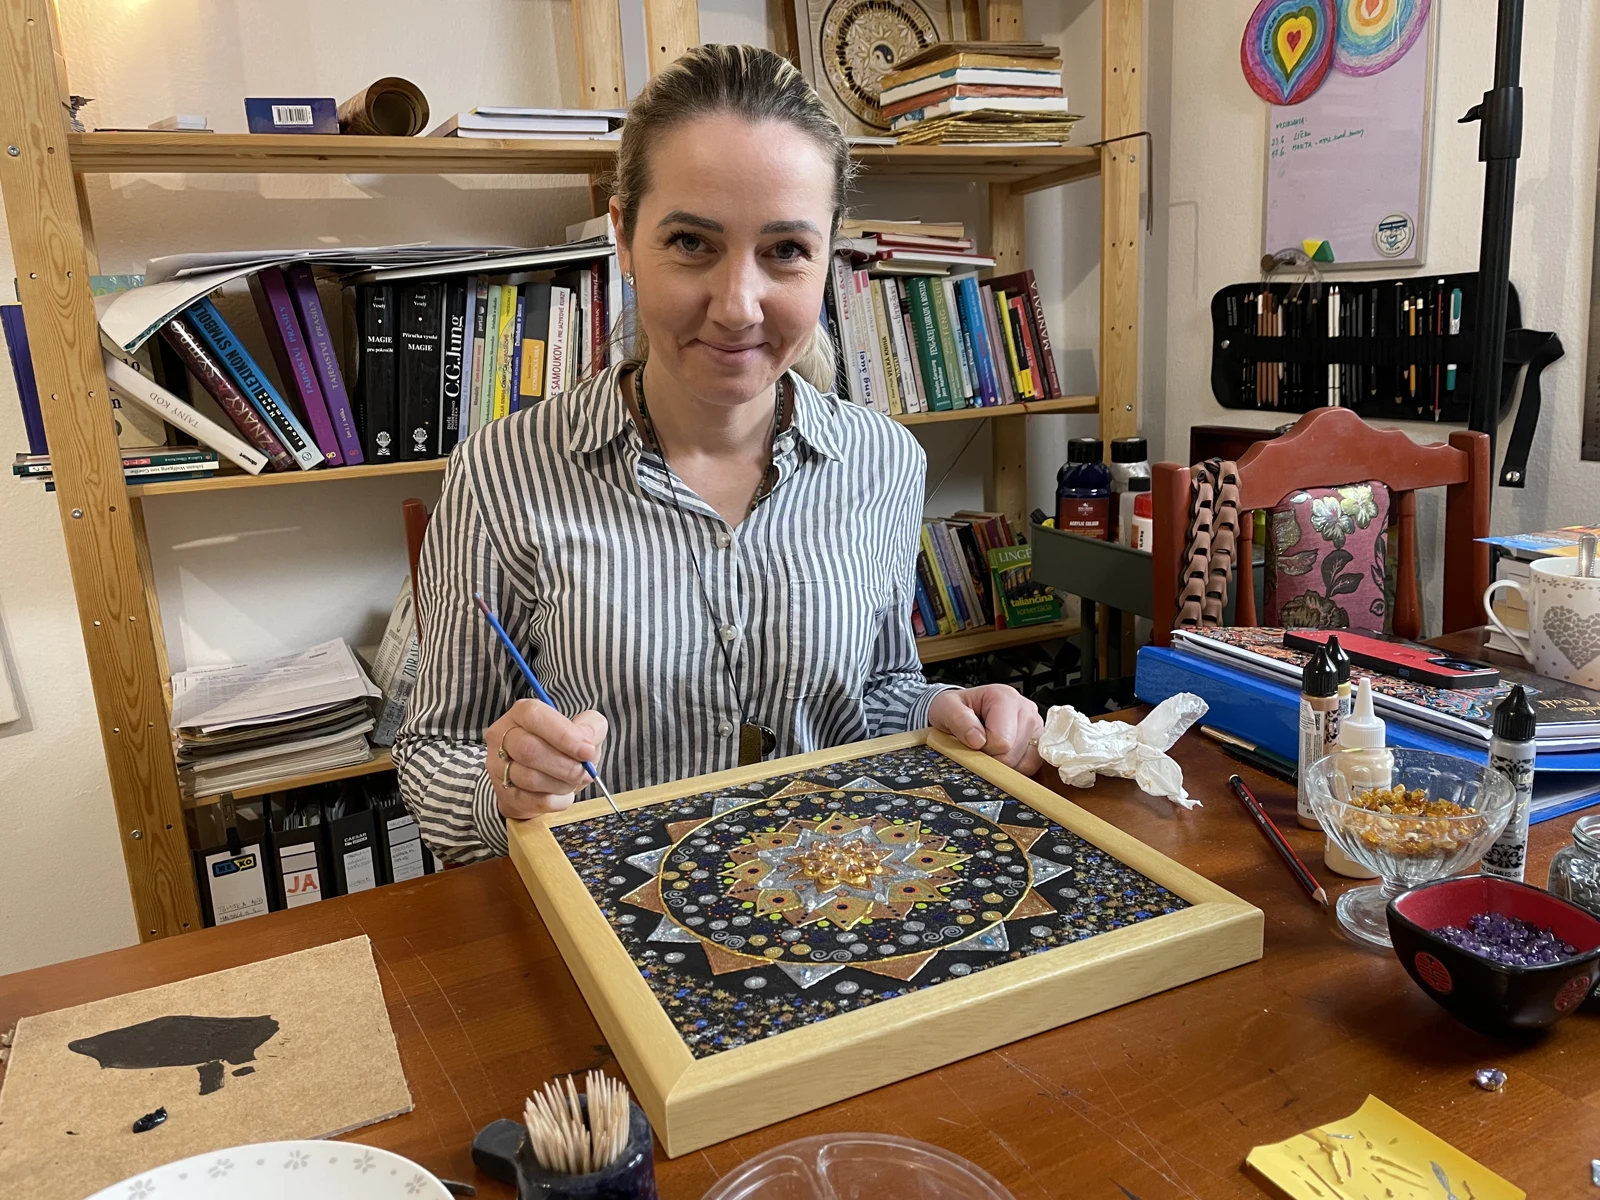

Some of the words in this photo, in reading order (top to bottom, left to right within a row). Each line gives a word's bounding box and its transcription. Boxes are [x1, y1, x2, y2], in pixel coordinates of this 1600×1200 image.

[407, 343, 433, 351] MAGIE
[551, 344, 562, 389] SAMOUKOV
[863, 377, 873, 406] Feng
[258, 394, 276, 418] Hans
[227, 396, 274, 448] ZNAKY
[263, 392, 304, 446] Biedermann
[1010, 594, 1053, 607] taliančina
[344, 833, 367, 842] CAESAR
[287, 874, 318, 894] JA
